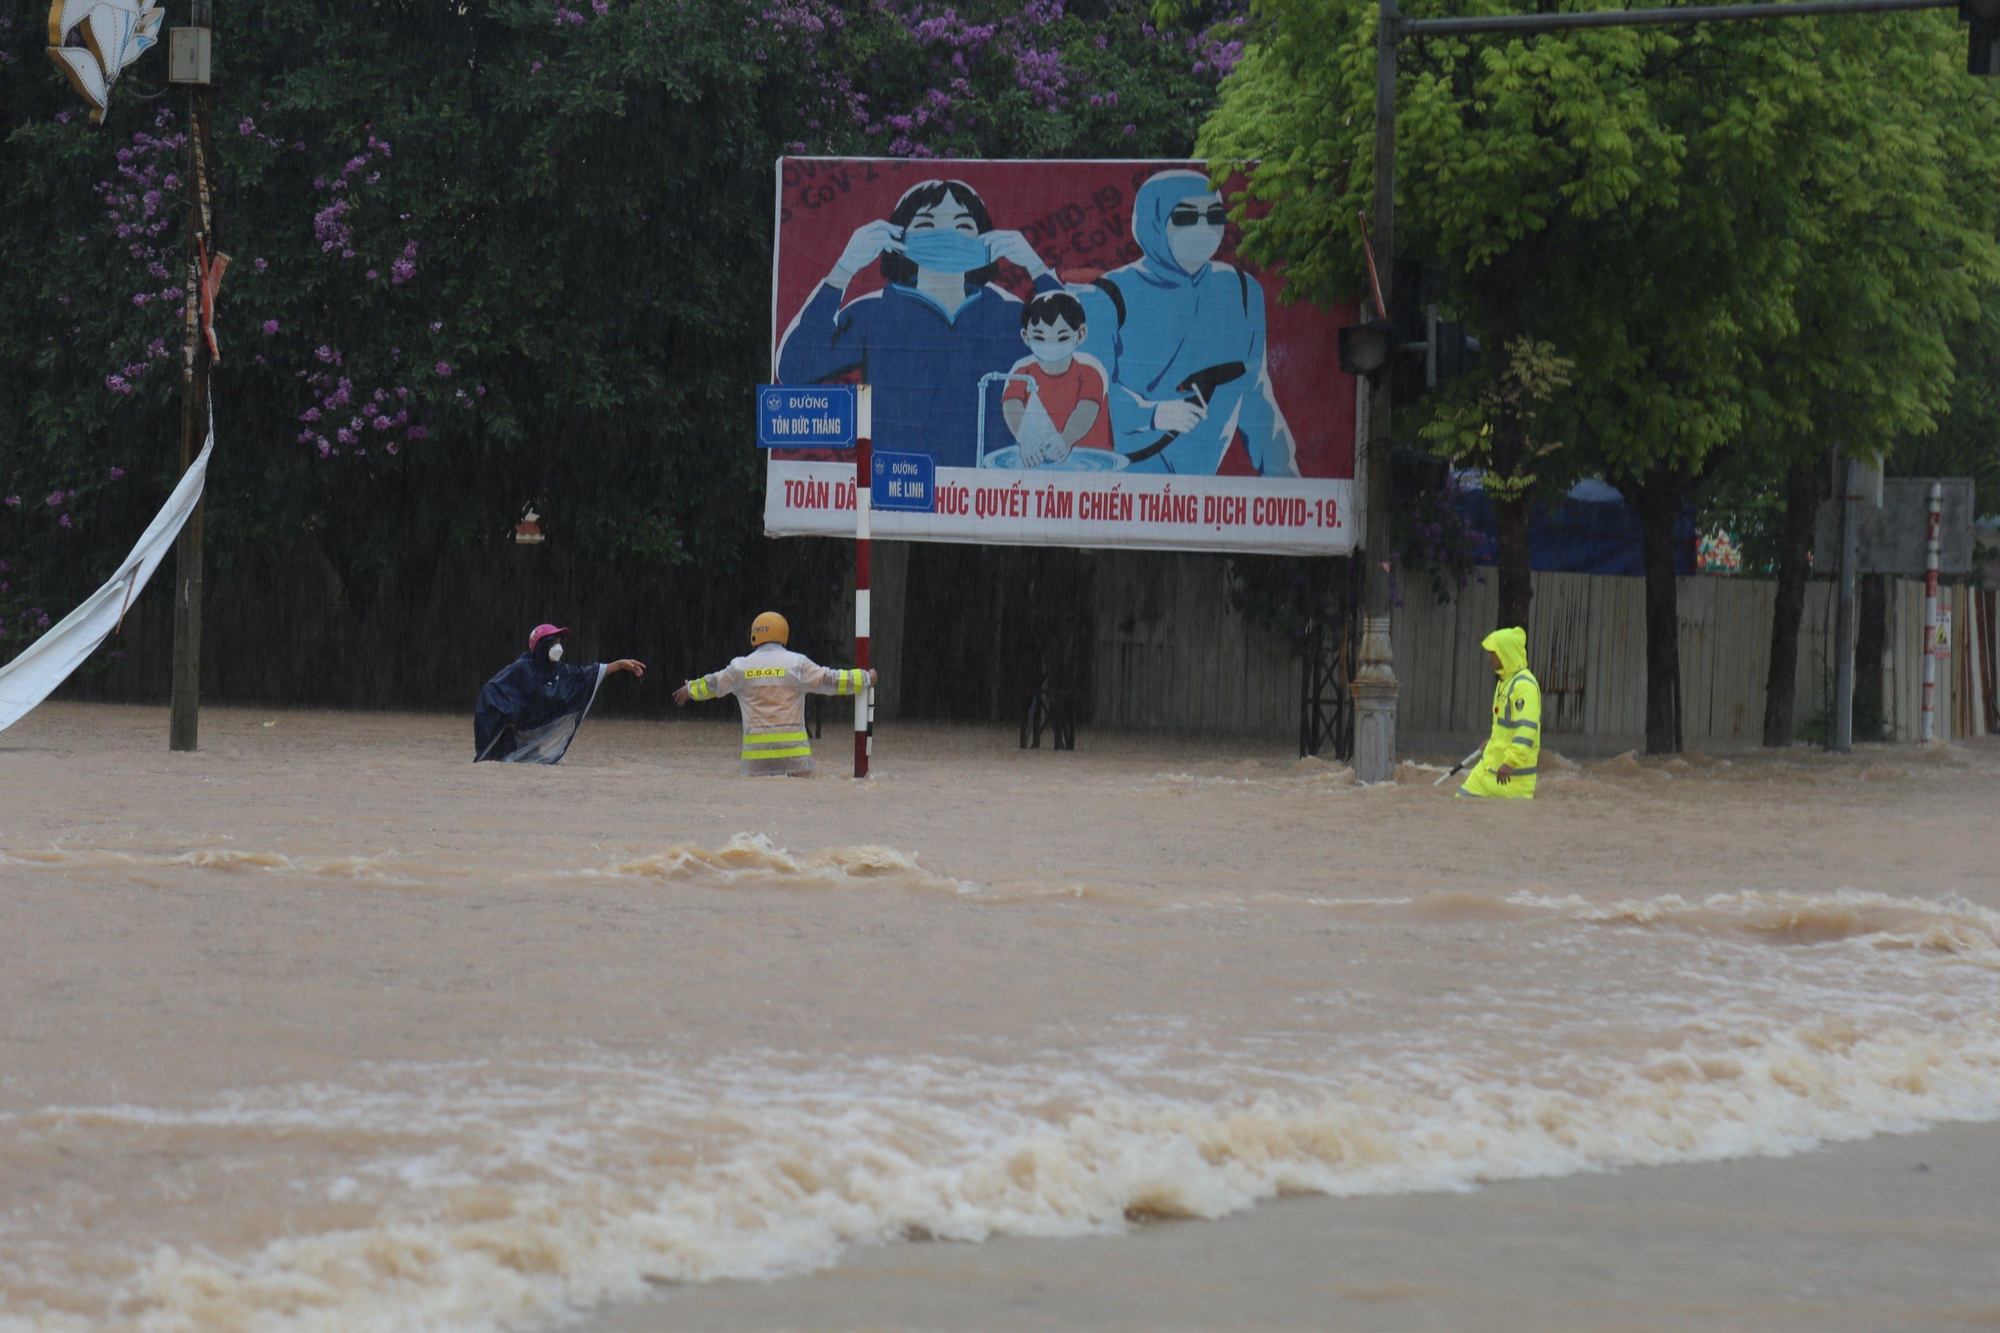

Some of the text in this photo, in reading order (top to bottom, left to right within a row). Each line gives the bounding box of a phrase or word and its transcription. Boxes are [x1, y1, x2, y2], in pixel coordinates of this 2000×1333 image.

[789, 395, 829, 409] ĐƯỜNG
[771, 411, 841, 435] TÔN ĐỨC THẮNG
[892, 460, 918, 475] ĐƯỜNG
[888, 479, 924, 498] MÊ LINH
[785, 475, 1342, 531] TOÀN DÂ HÚC QUYẾT TÂM CHIẾN THẮNG DỊCH COVID-19.
